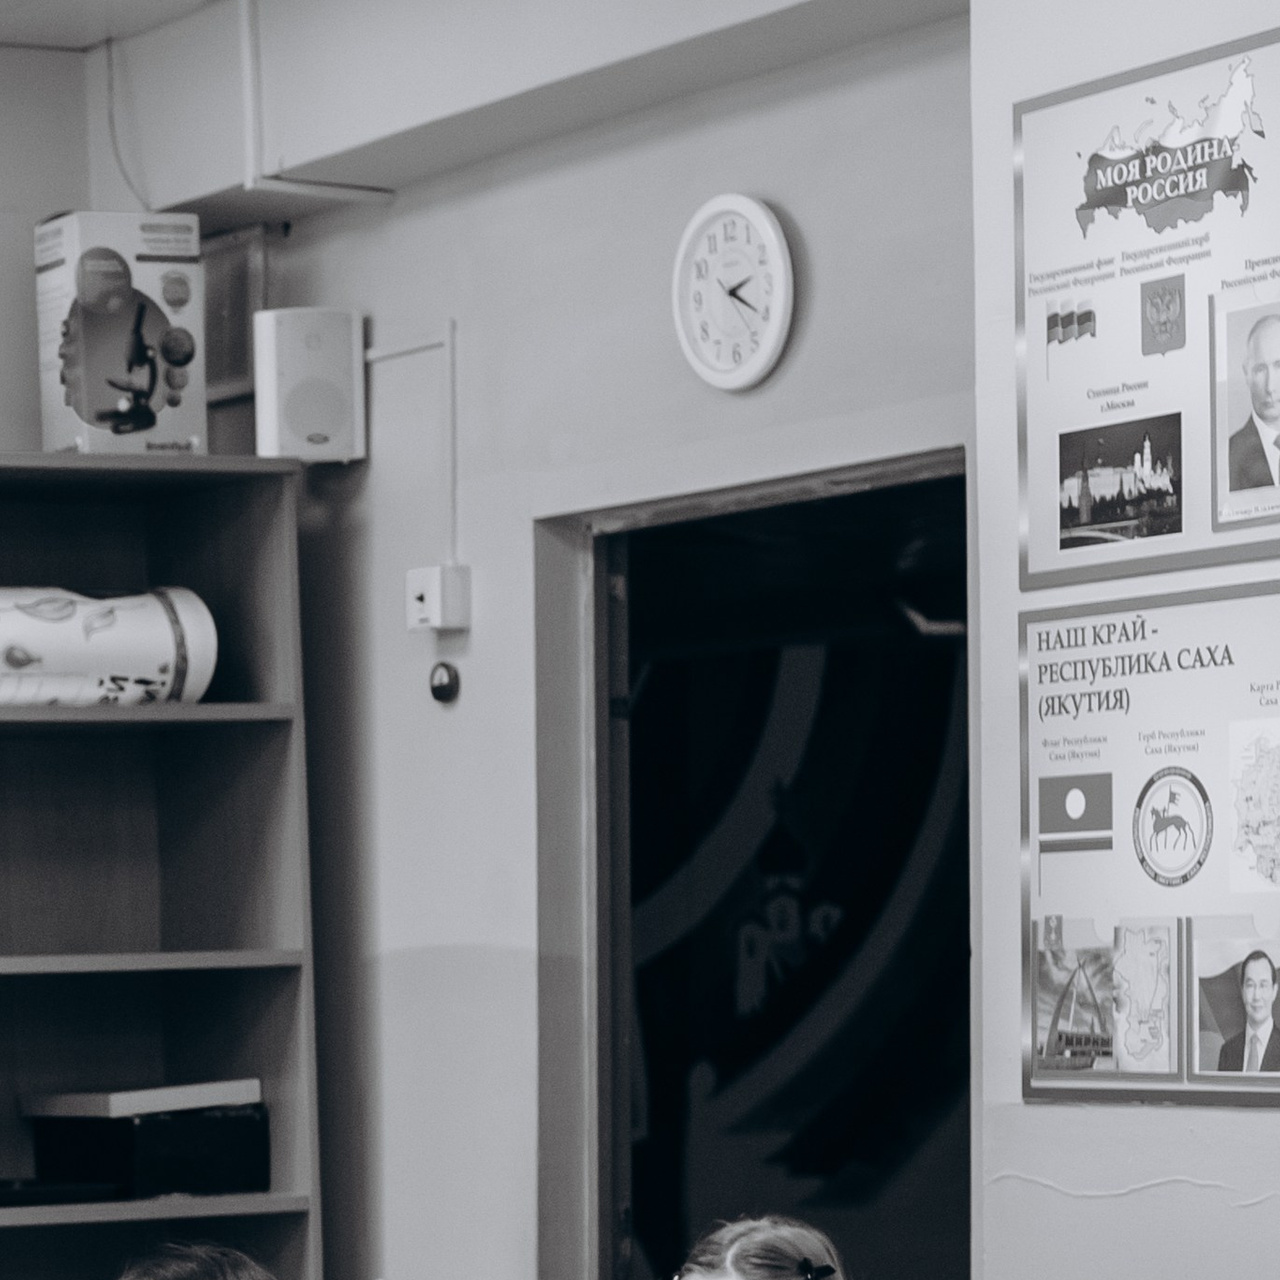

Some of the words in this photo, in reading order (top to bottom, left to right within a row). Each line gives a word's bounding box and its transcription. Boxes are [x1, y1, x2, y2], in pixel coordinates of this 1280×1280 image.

[1096, 158, 1140, 190] МОЯ
[1126, 168, 1208, 207] РОССИЯ
[1037, 627, 1086, 652] НАШ
[1092, 614, 1147, 645] КРАЙ
[1037, 651, 1172, 685] РЕСПУБЛИКА
[1177, 644, 1235, 670] САХА
[1038, 687, 1131, 723] (ЯКУТИЯ)
